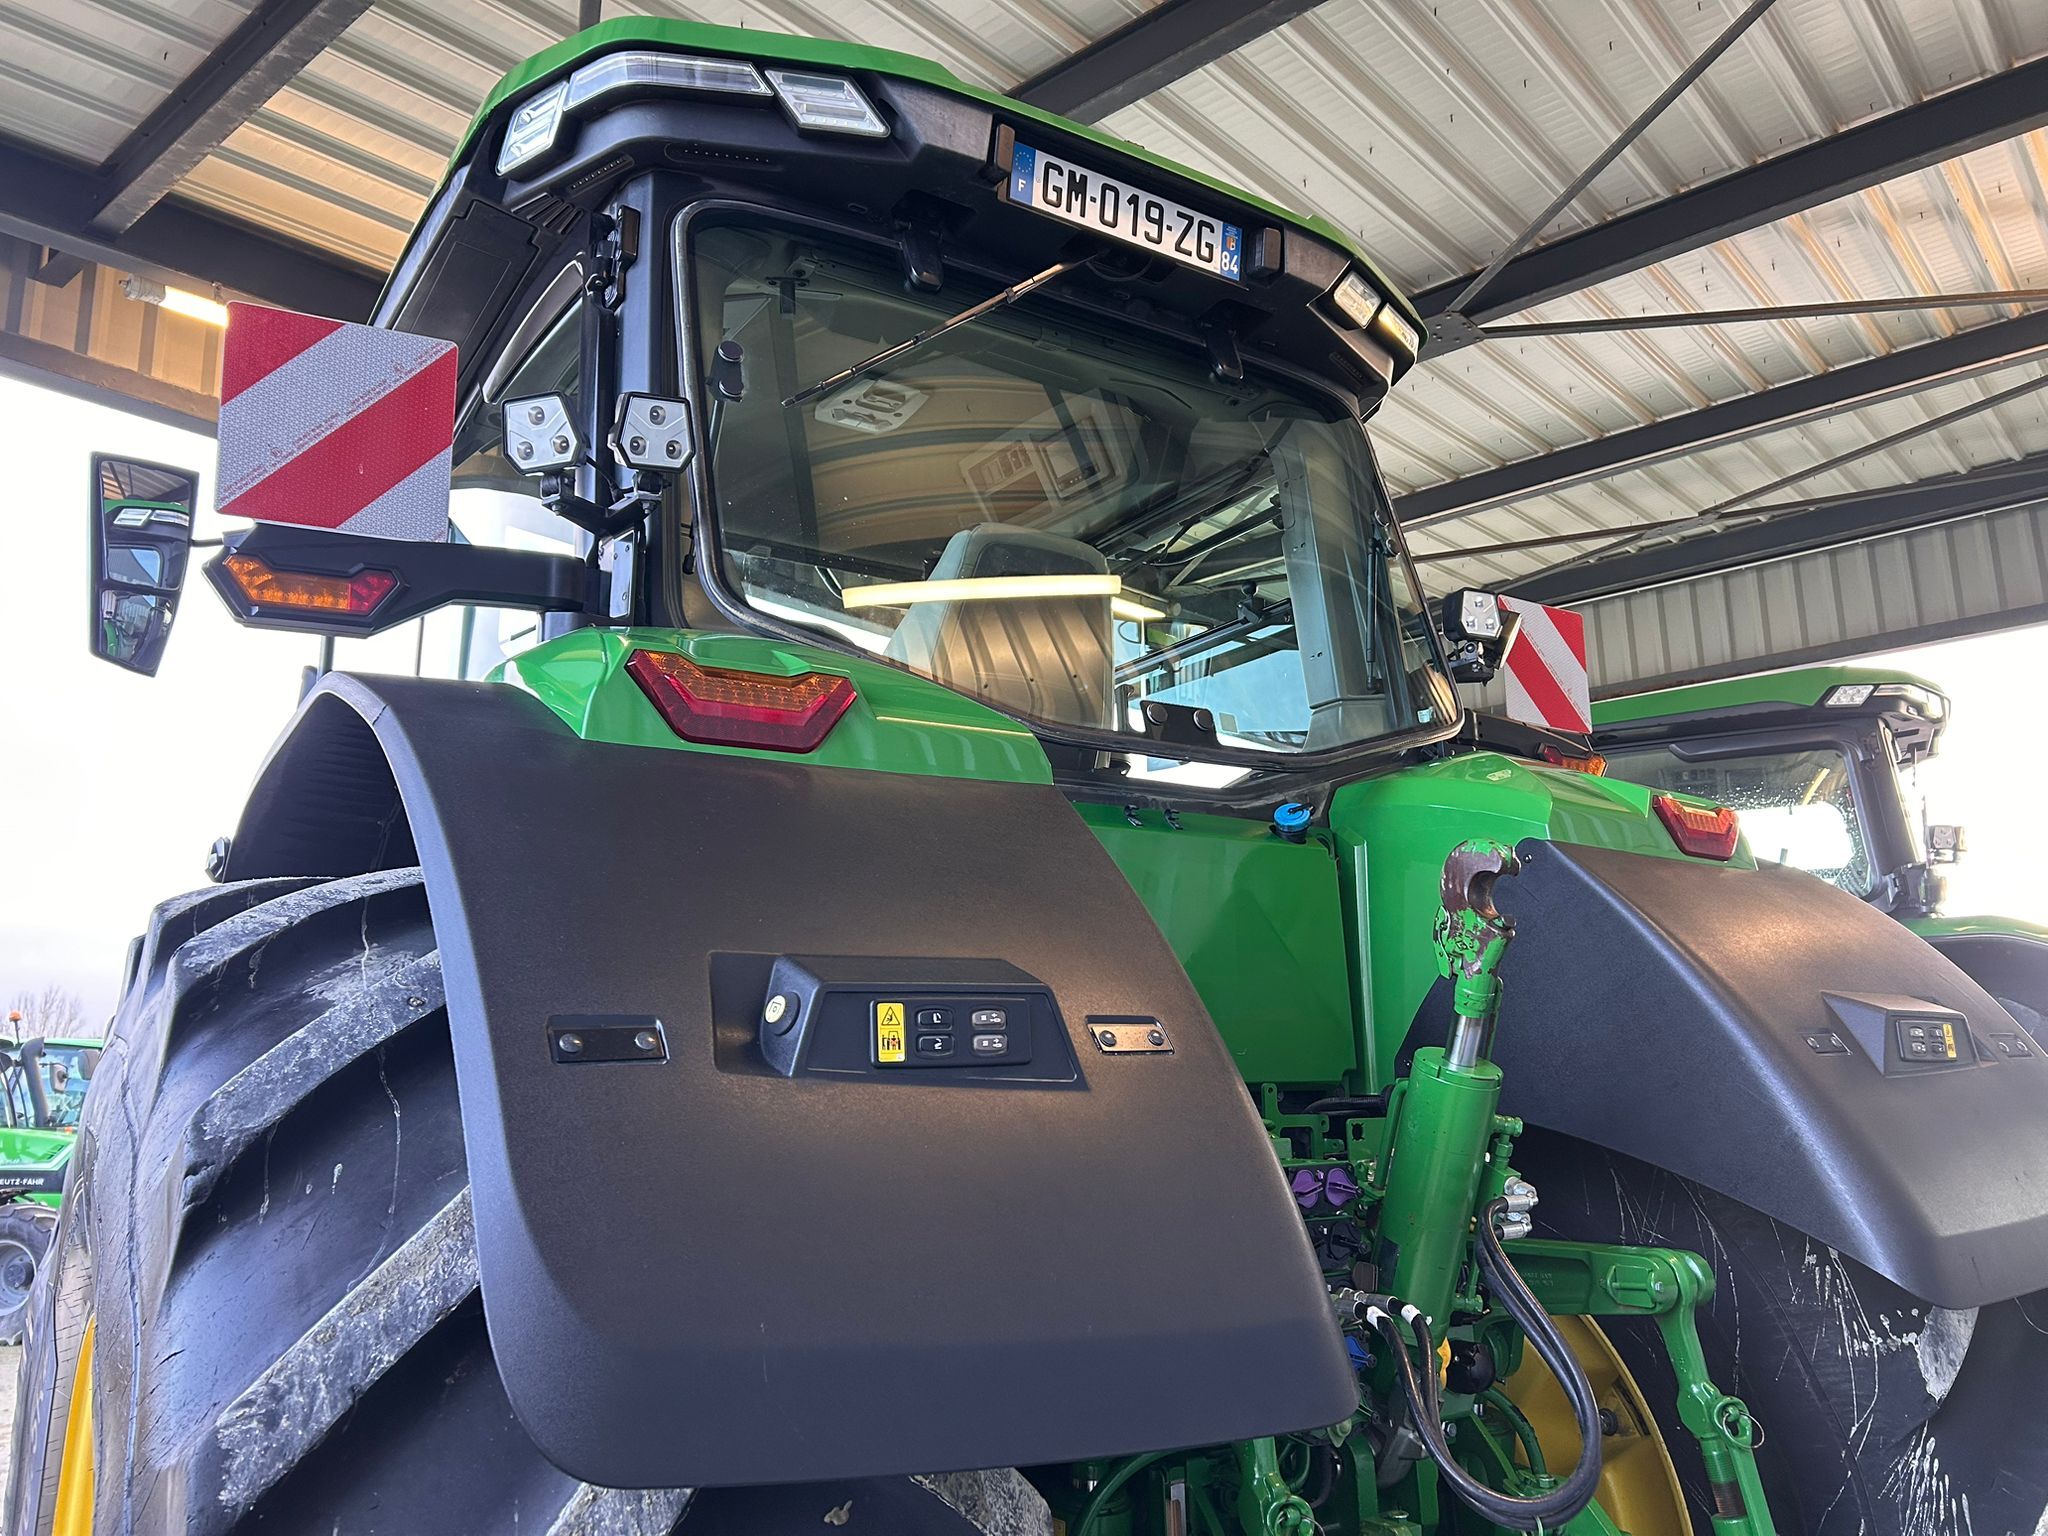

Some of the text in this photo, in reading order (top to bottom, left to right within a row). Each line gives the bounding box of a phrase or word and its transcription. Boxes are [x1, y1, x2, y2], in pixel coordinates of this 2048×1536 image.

[1018, 178, 1026, 192] F
[1042, 161, 1215, 264] GM-019-ZG
[1221, 251, 1239, 275] 84
[0, 1178, 44, 1186] EUTZ-FAHR
